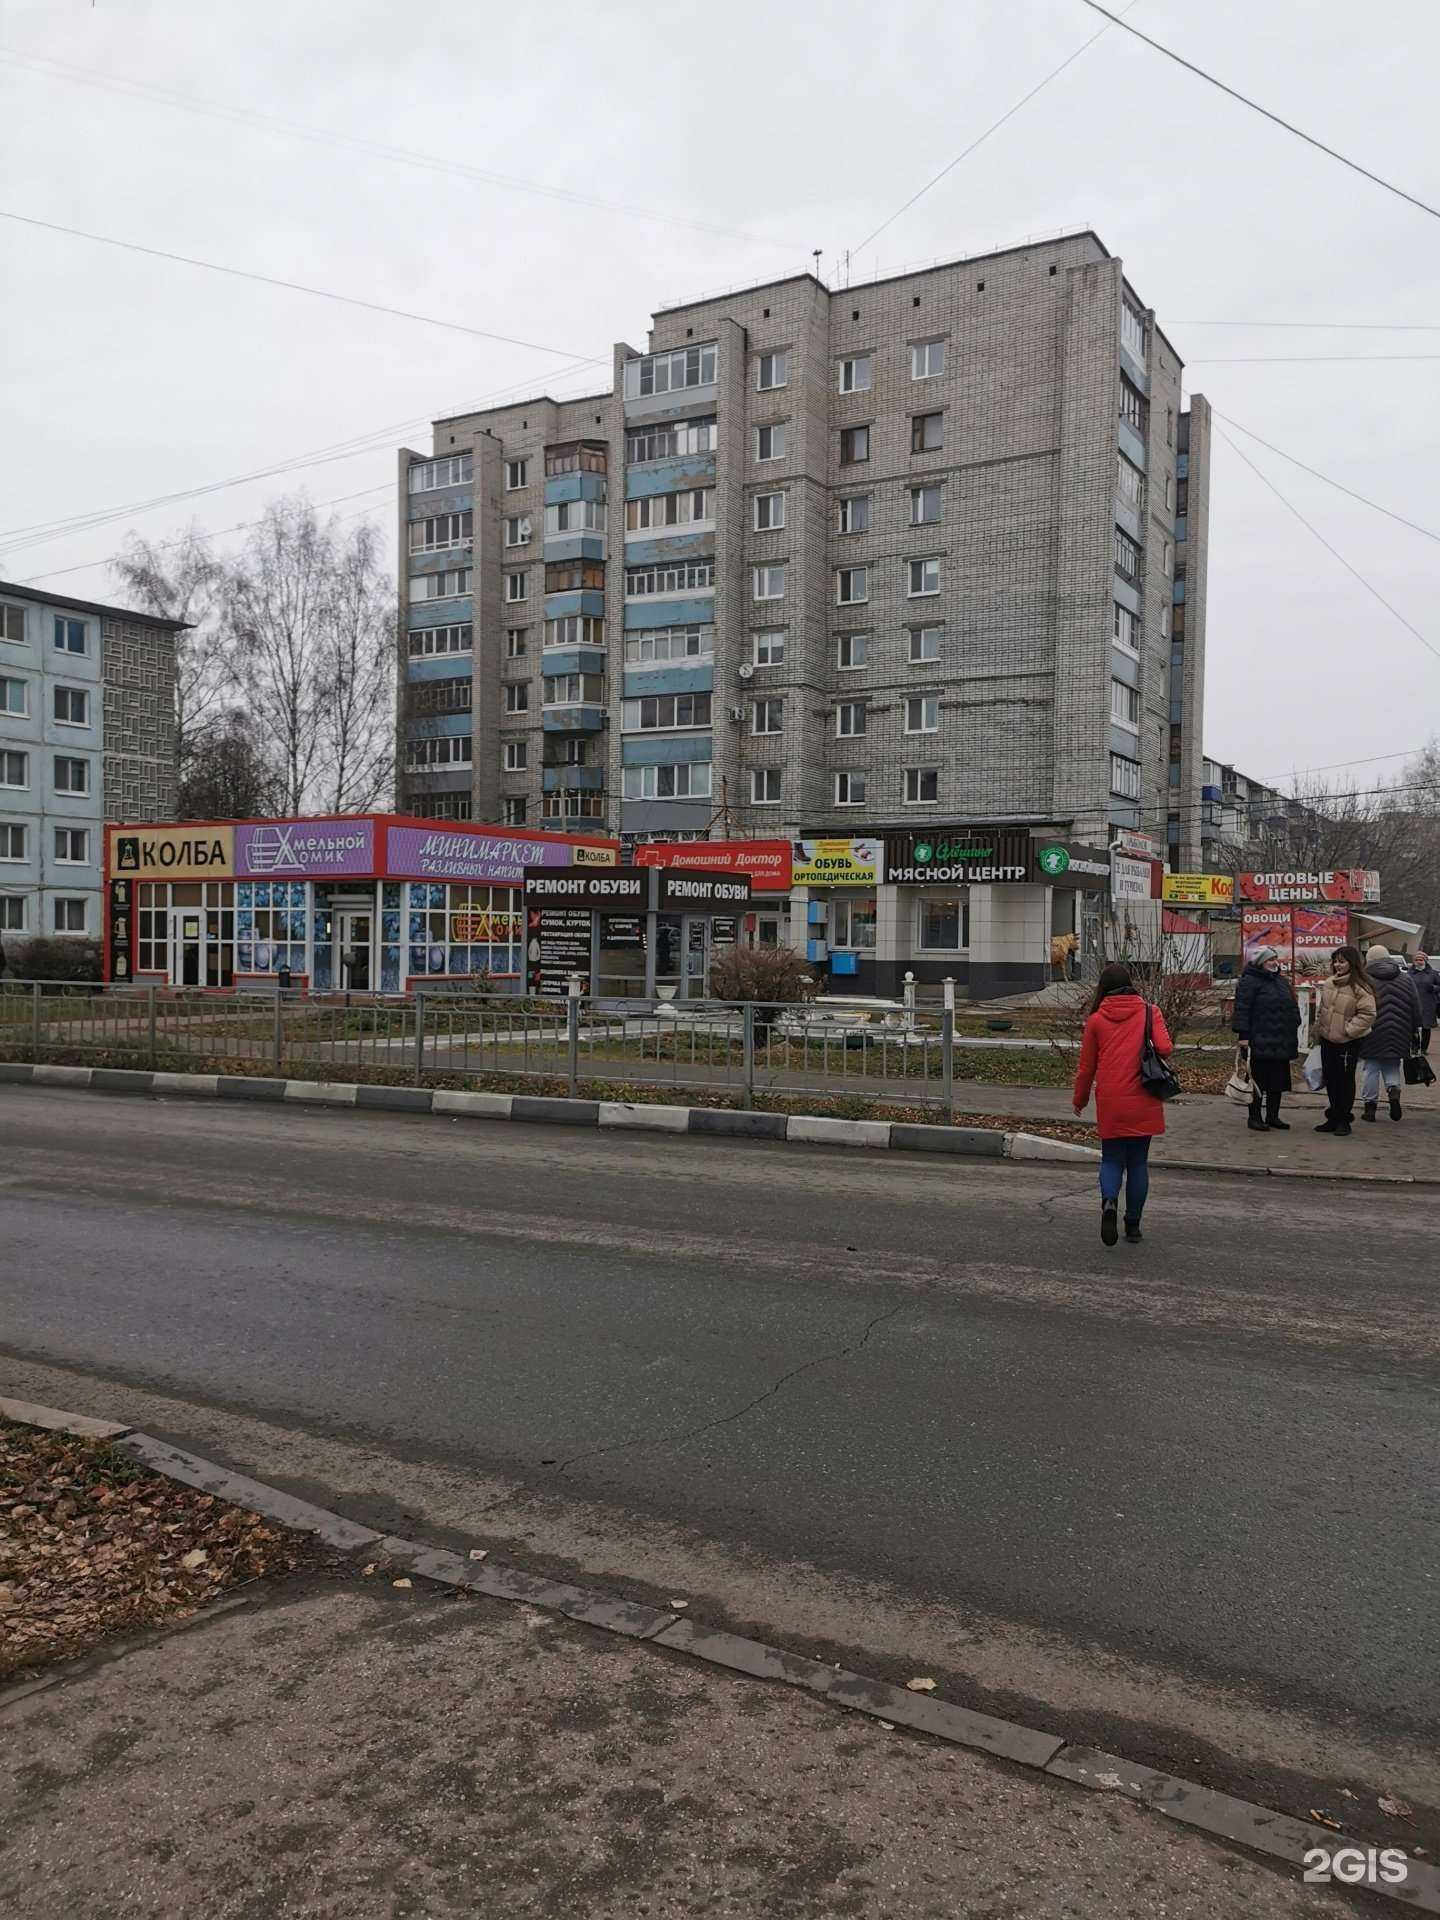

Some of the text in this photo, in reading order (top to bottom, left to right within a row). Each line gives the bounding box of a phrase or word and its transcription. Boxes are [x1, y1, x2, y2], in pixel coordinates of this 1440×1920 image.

[142, 840, 226, 866] КОЛБА
[584, 853, 611, 863] КОЛБА
[671, 853, 783, 867] Домашний Доктор
[815, 858, 852, 870] ОБУВЬ
[487, 865, 525, 879] НАПИТ
[794, 871, 874, 883] ОРТОПЕДИЧЕСКАЯ
[888, 864, 1026, 882] МЯСНОЙ ЦЕНТР
[1254, 872, 1335, 886] ОПТОВЫЕ
[526, 879, 641, 895] РЕМОНТ ОБУВИ
[667, 879, 749, 901] РЕМОНТ ОБУВИ
[1211, 878, 1232, 896] Kod
[1269, 887, 1318, 902] ЦЕНЫ
[1244, 913, 1291, 924] ОВОЩИ
[1296, 935, 1347, 945] ФРУКТЫ
